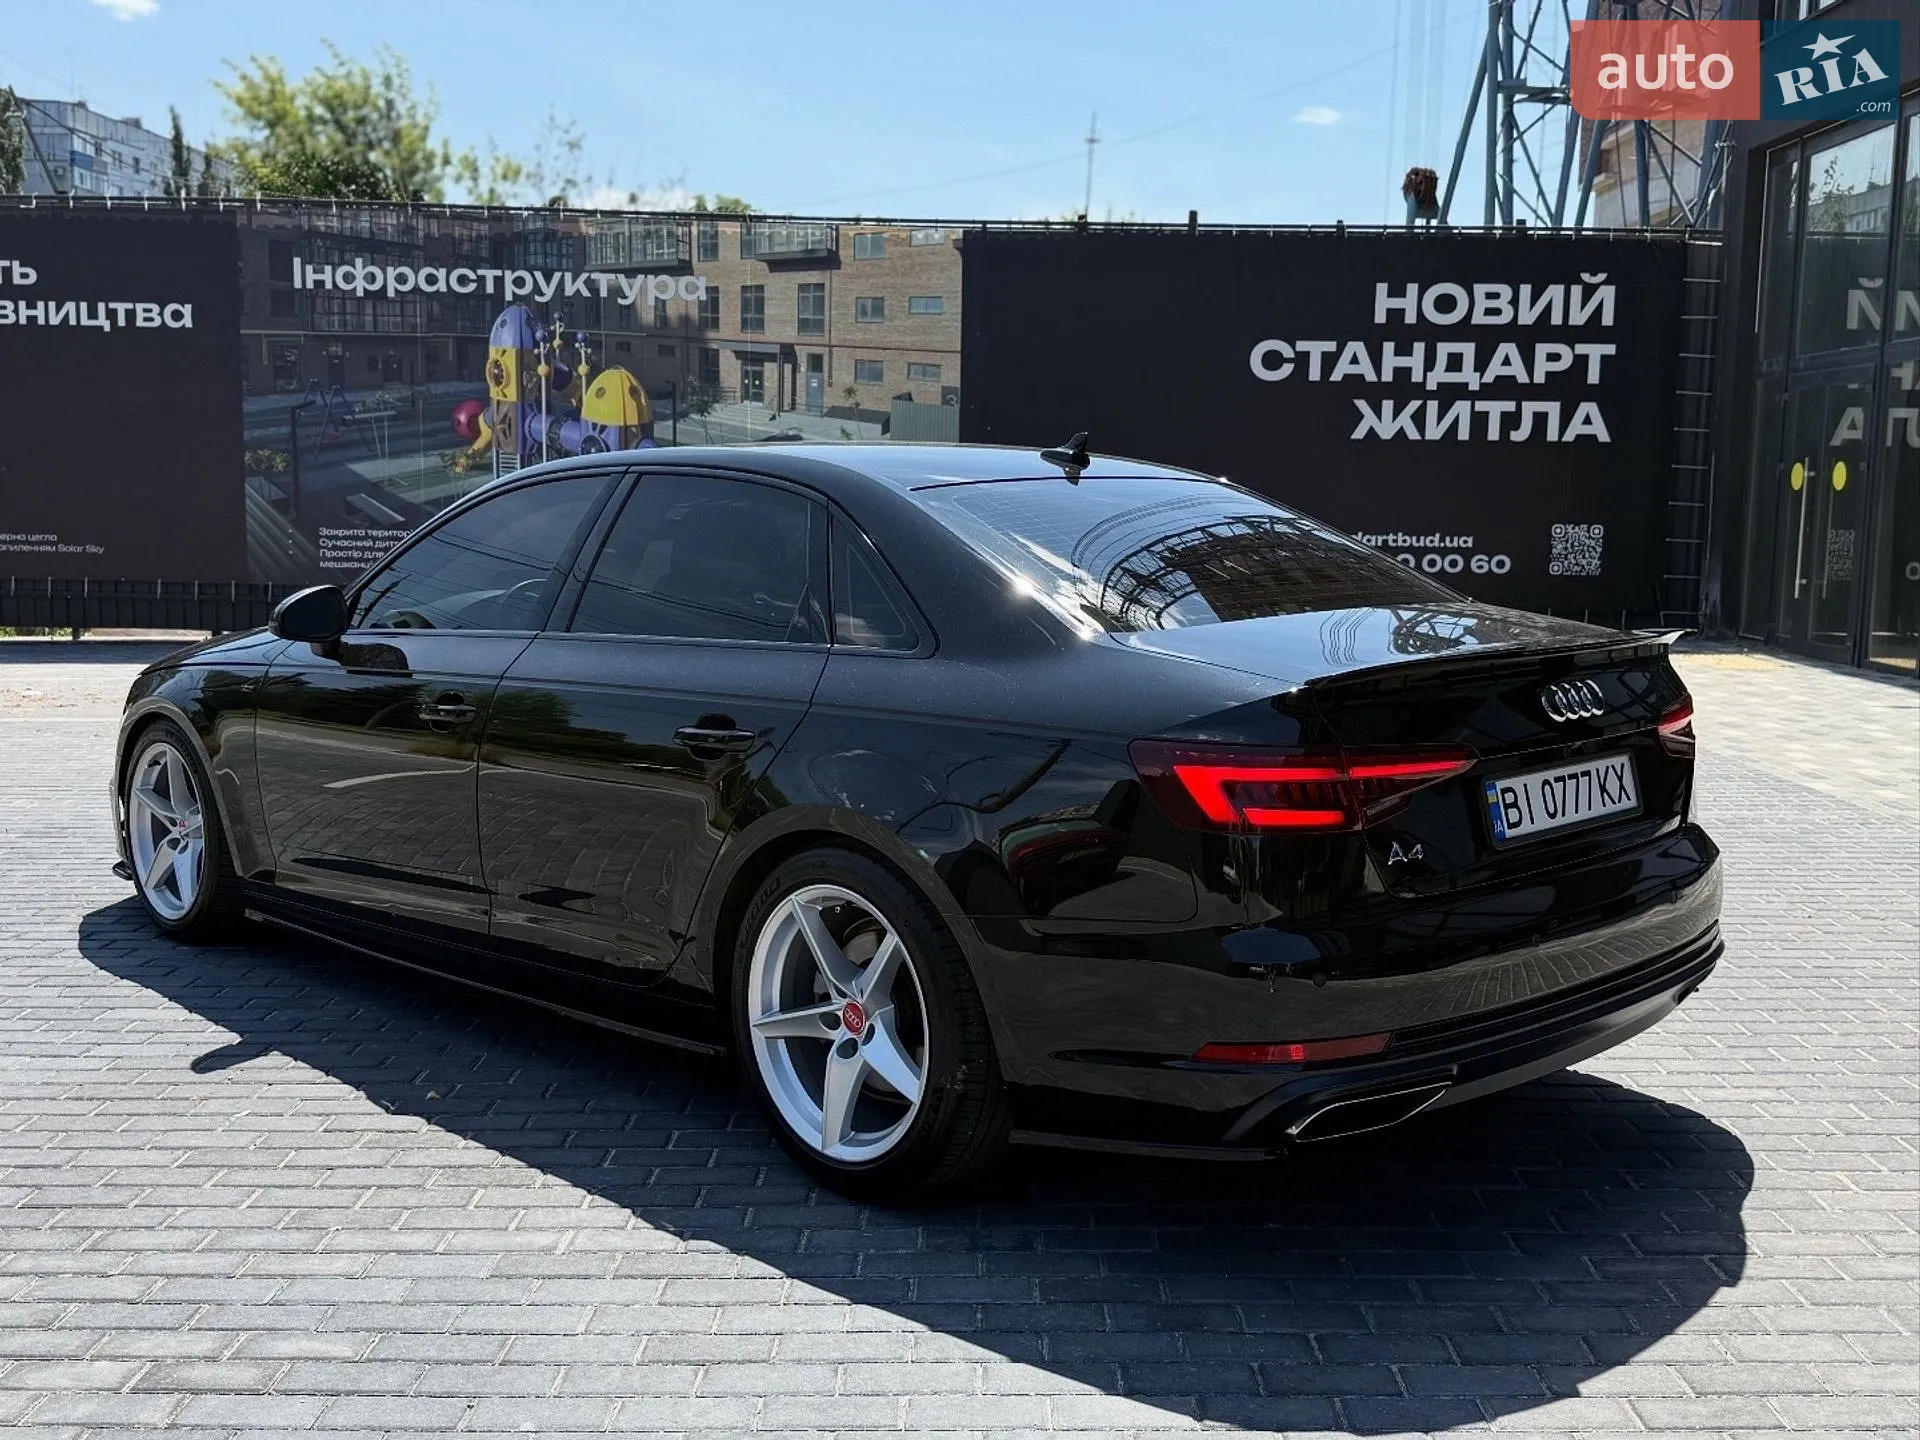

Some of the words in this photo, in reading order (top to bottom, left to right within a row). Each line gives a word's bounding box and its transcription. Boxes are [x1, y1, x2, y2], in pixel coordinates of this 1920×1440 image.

[292, 256, 708, 306] Інфраструктура
[1373, 272, 1617, 327] НОВИЙ
[1249, 339, 1617, 391] СТАНДАРТ
[1349, 398, 1612, 443] ЖИТЛА
[318, 526, 366, 537] Закрита
[318, 538, 374, 548] Сучасний
[57, 543, 84, 553] Solar
[86, 543, 105, 555] Sky
[319, 548, 363, 559] Простір
[1387, 841, 1424, 865] A4
